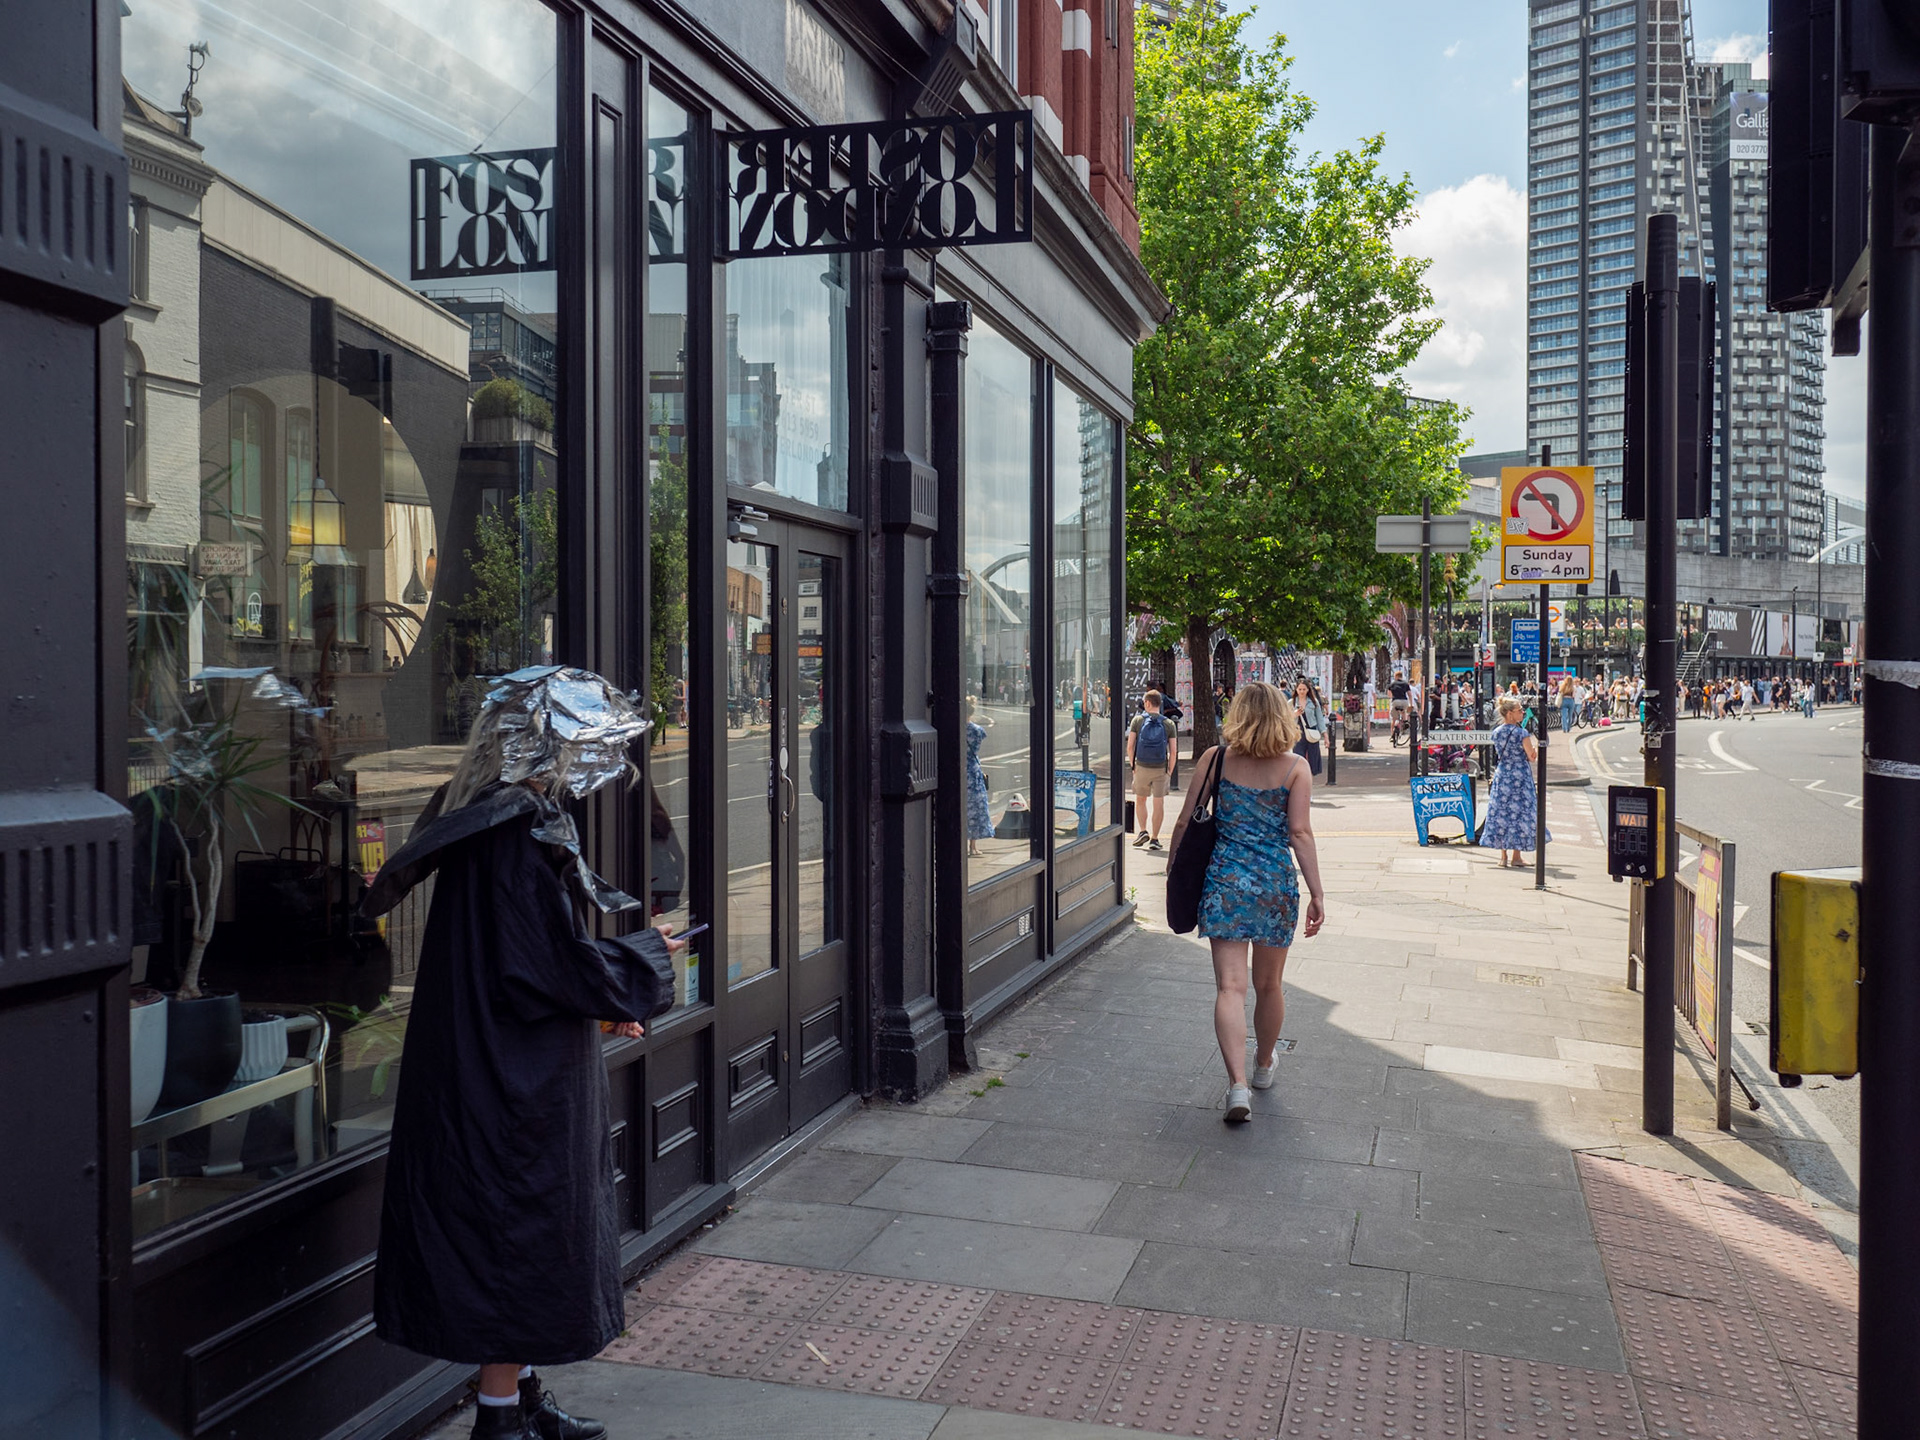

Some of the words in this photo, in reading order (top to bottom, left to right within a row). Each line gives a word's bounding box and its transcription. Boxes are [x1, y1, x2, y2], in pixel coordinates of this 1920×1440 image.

[1522, 549, 1573, 562] Sunday
[1510, 564, 1519, 576] 8
[1551, 564, 1561, 575] 4
[1563, 566, 1585, 577] pm
[1707, 609, 1738, 631] BOXPARK
[1429, 733, 1467, 741] SCLATER
[1619, 813, 1648, 827] WAIT
